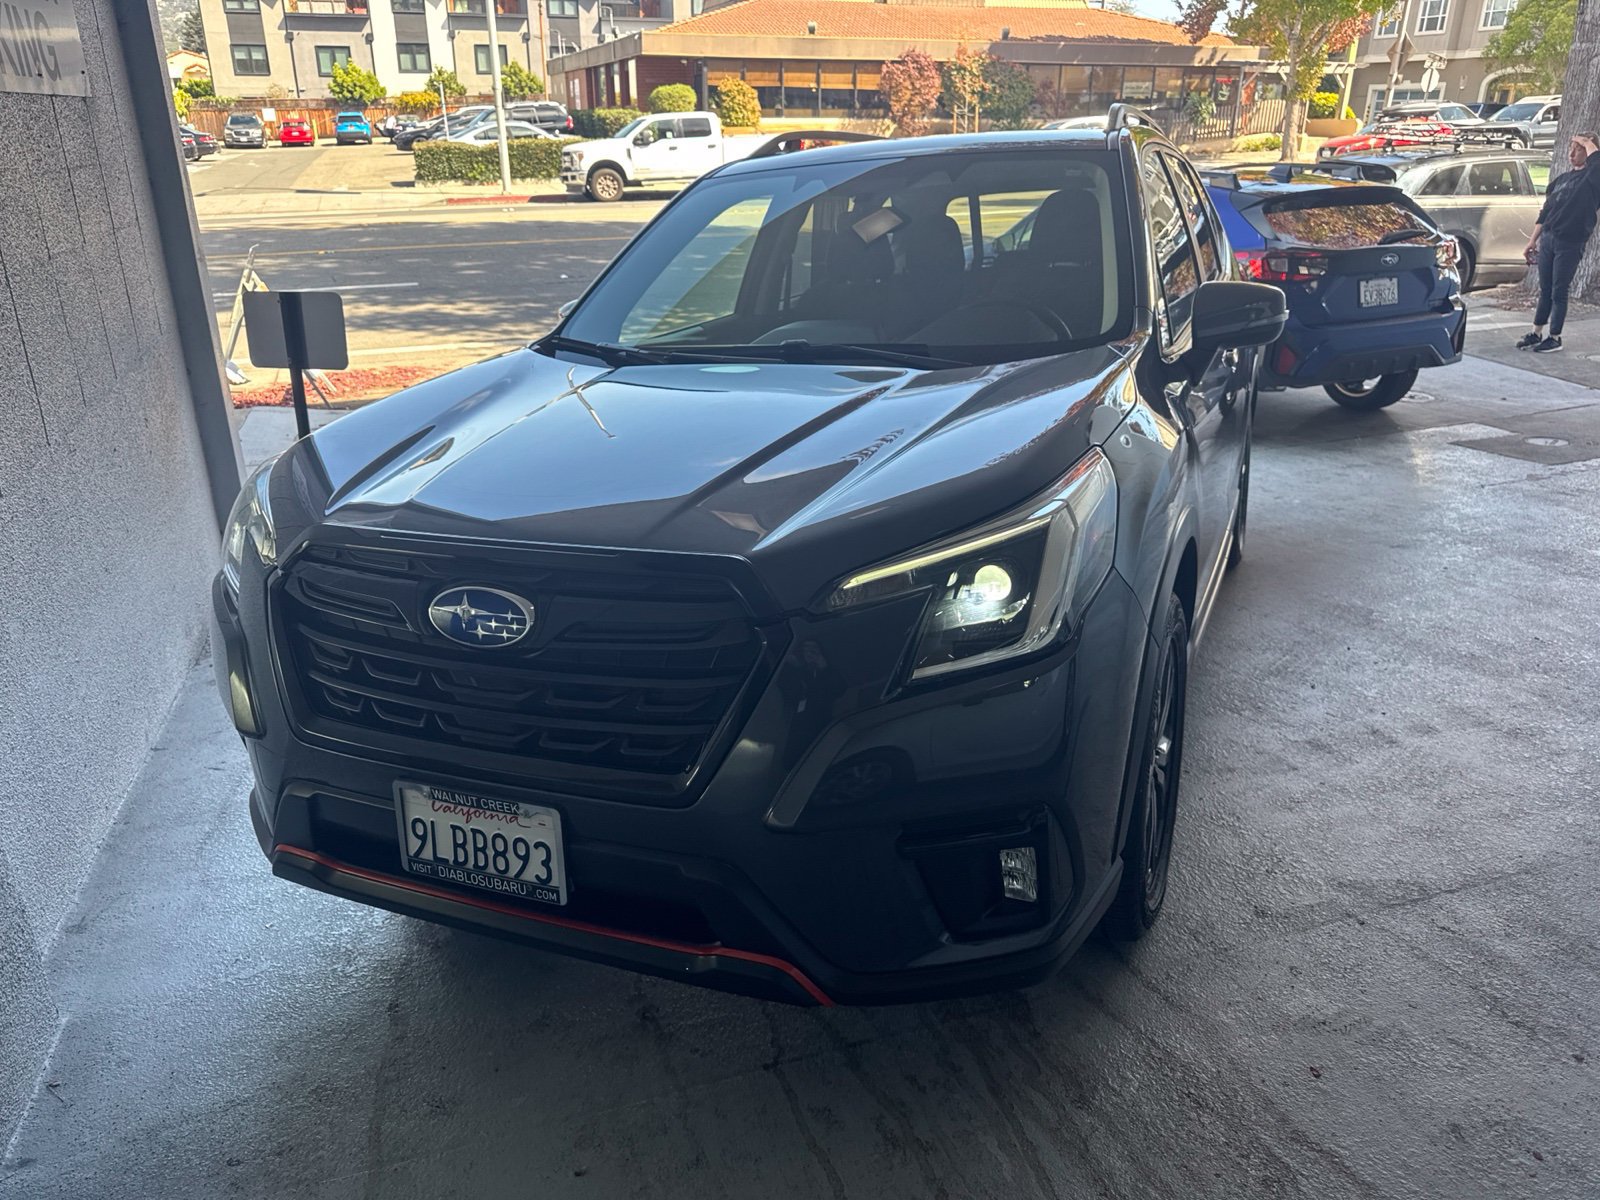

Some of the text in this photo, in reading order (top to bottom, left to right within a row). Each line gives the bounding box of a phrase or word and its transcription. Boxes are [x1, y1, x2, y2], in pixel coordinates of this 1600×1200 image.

[431, 788, 520, 814] WALNUT CREEK
[431, 800, 531, 829] California
[411, 817, 553, 885] 9LBB893
[411, 861, 432, 874] VISIT
[438, 865, 527, 895] DIABLOSUBARU
